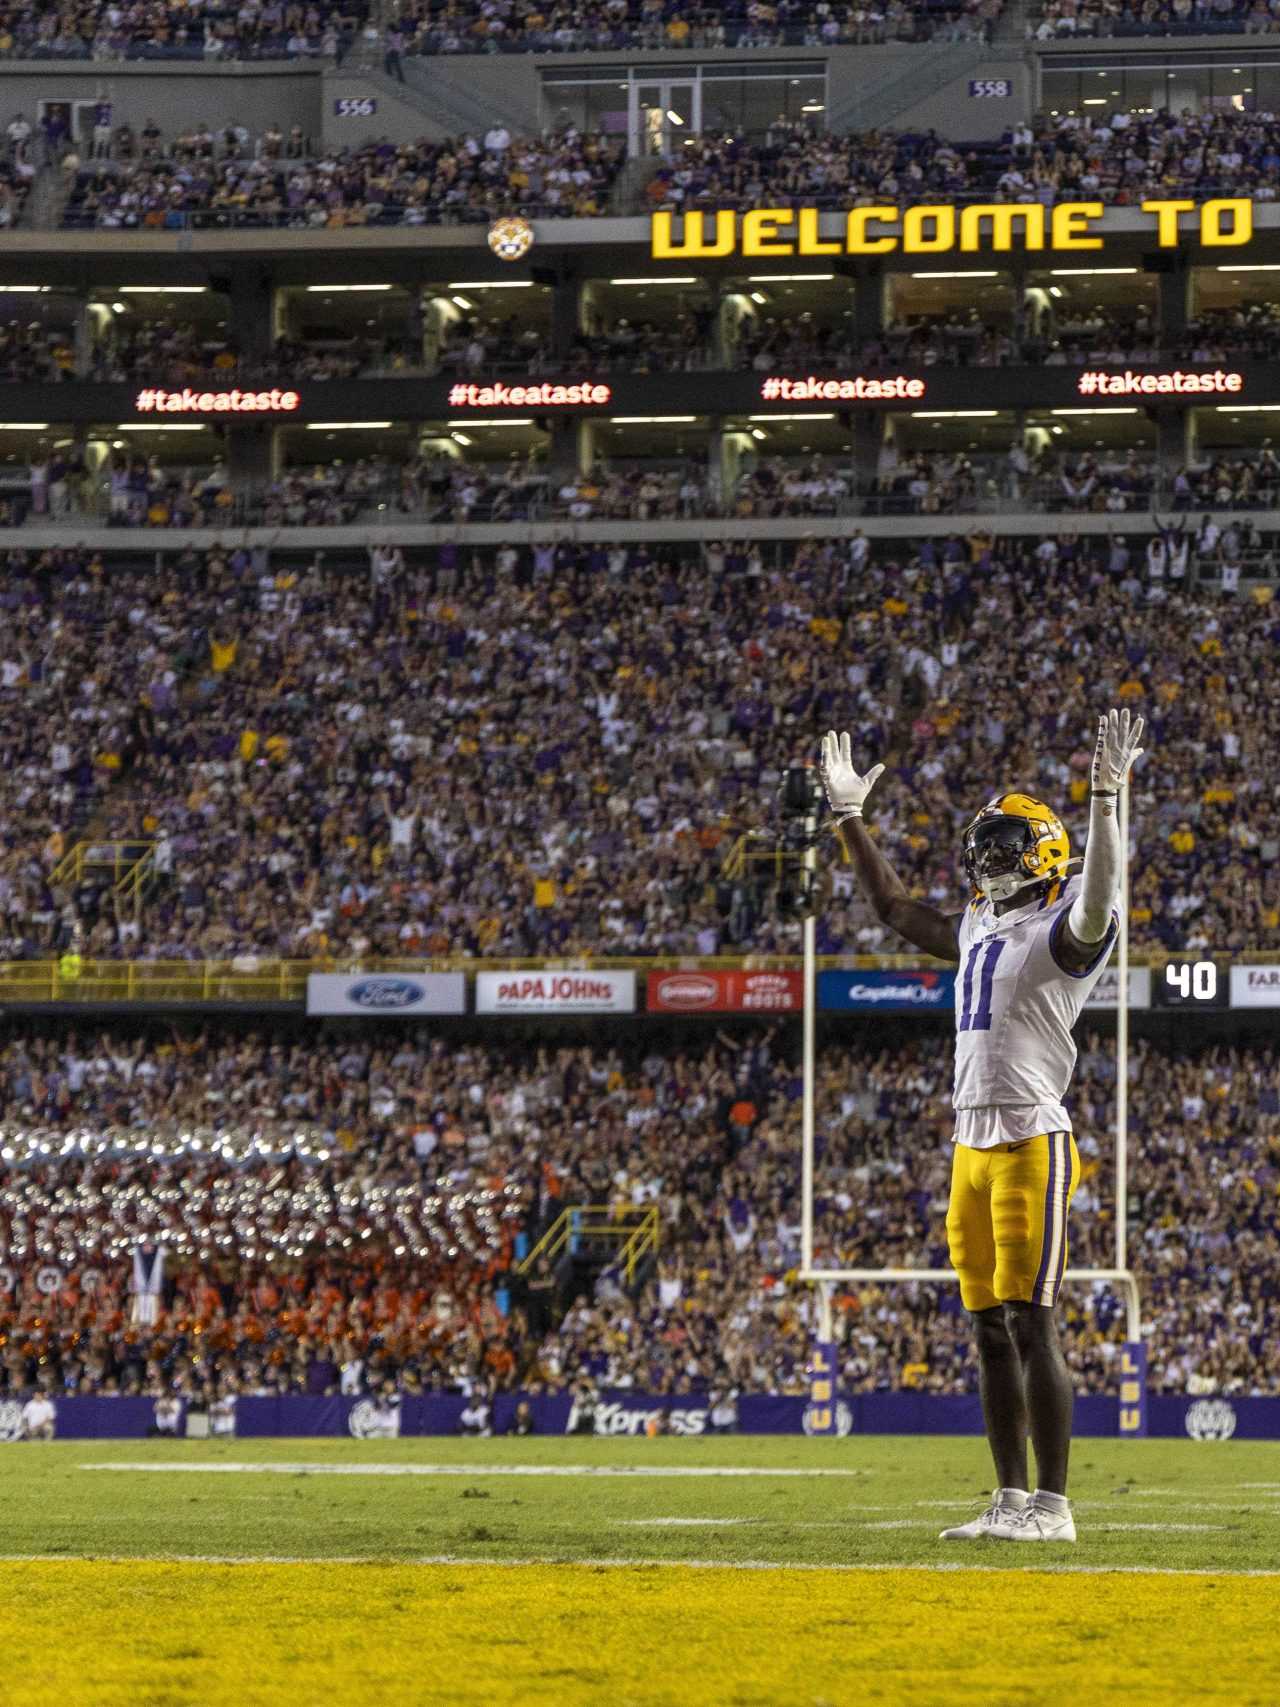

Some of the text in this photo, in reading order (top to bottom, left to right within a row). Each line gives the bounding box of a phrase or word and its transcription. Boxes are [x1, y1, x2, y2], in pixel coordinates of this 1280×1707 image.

[974, 81, 1007, 97] 558
[340, 99, 374, 116] 556
[652, 203, 1104, 258] WELCOME
[1142, 199, 1253, 247] TO
[761, 377, 925, 400] #takeataste
[1078, 370, 1243, 395] #takeataste
[136, 389, 300, 412] #takeataste
[448, 383, 611, 406] #takeataste
[497, 979, 545, 1000] PAPA
[959, 941, 1008, 1031] 11
[1166, 961, 1217, 1000] 40
